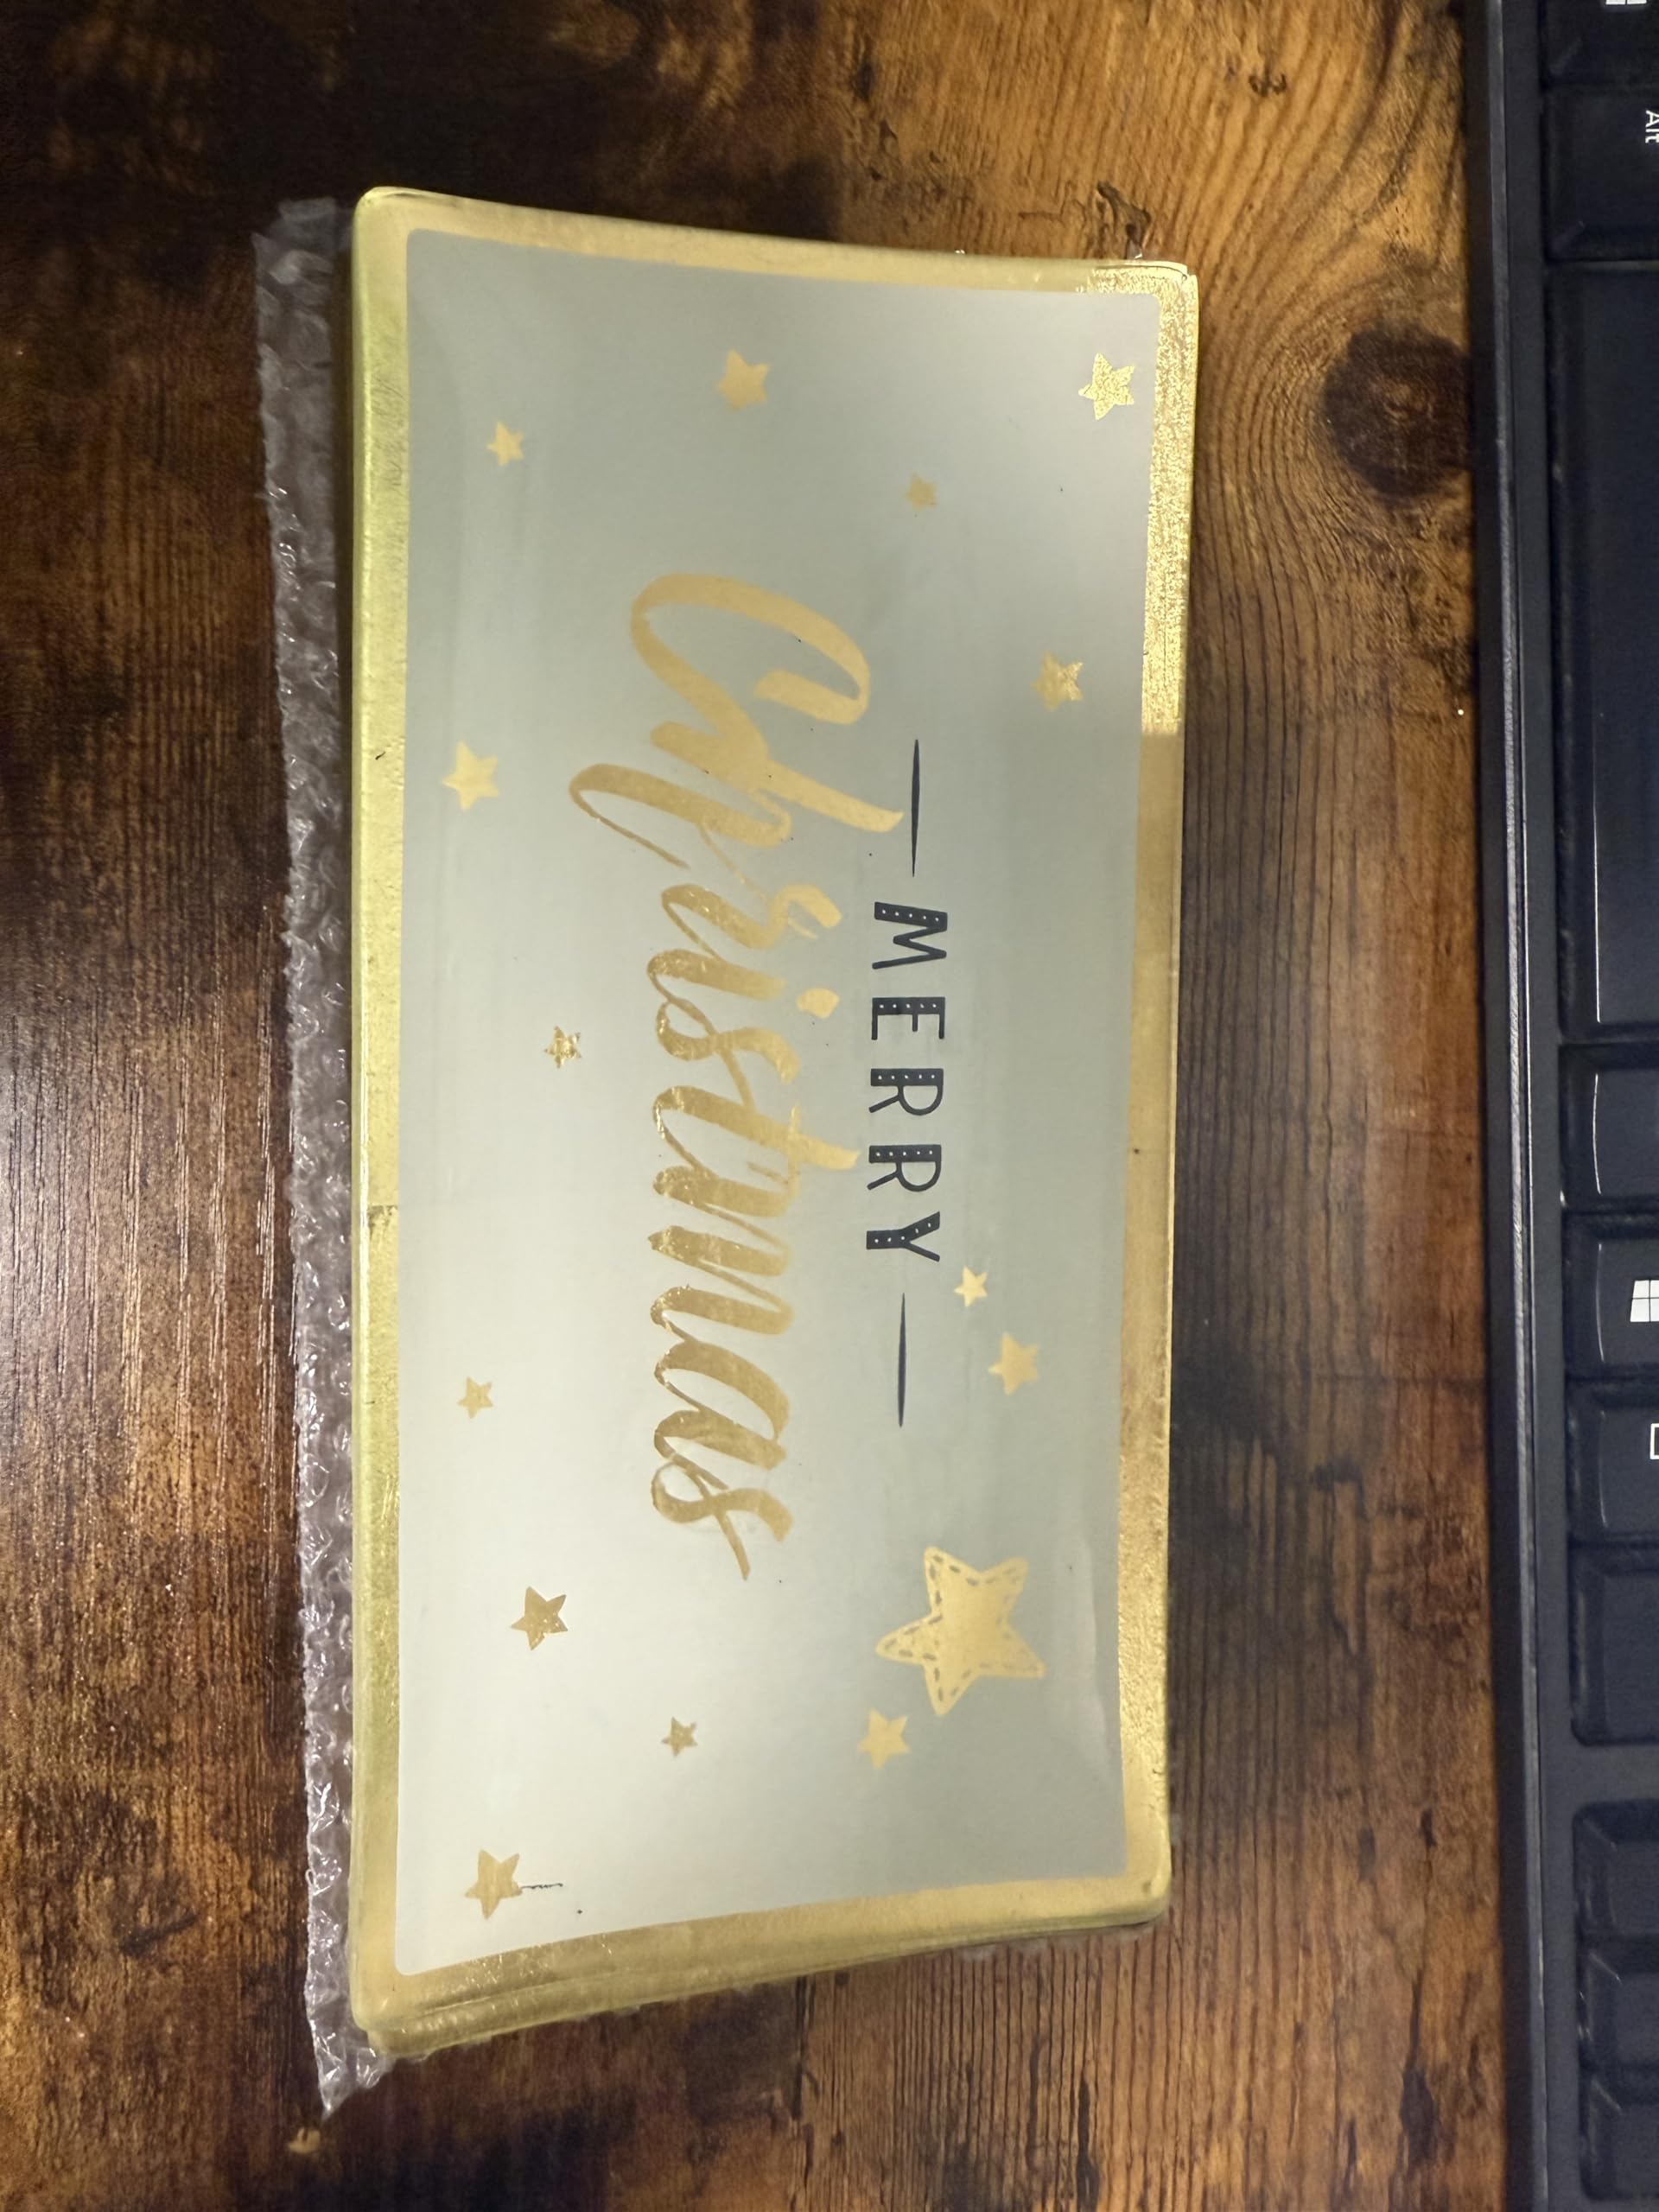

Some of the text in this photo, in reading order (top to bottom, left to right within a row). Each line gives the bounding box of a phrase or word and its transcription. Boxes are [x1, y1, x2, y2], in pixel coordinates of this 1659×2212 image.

[1645, 110, 1659, 143] Alt
[569, 572, 904, 1580] Christmas
[866, 901, 948, 1262] MERRY
